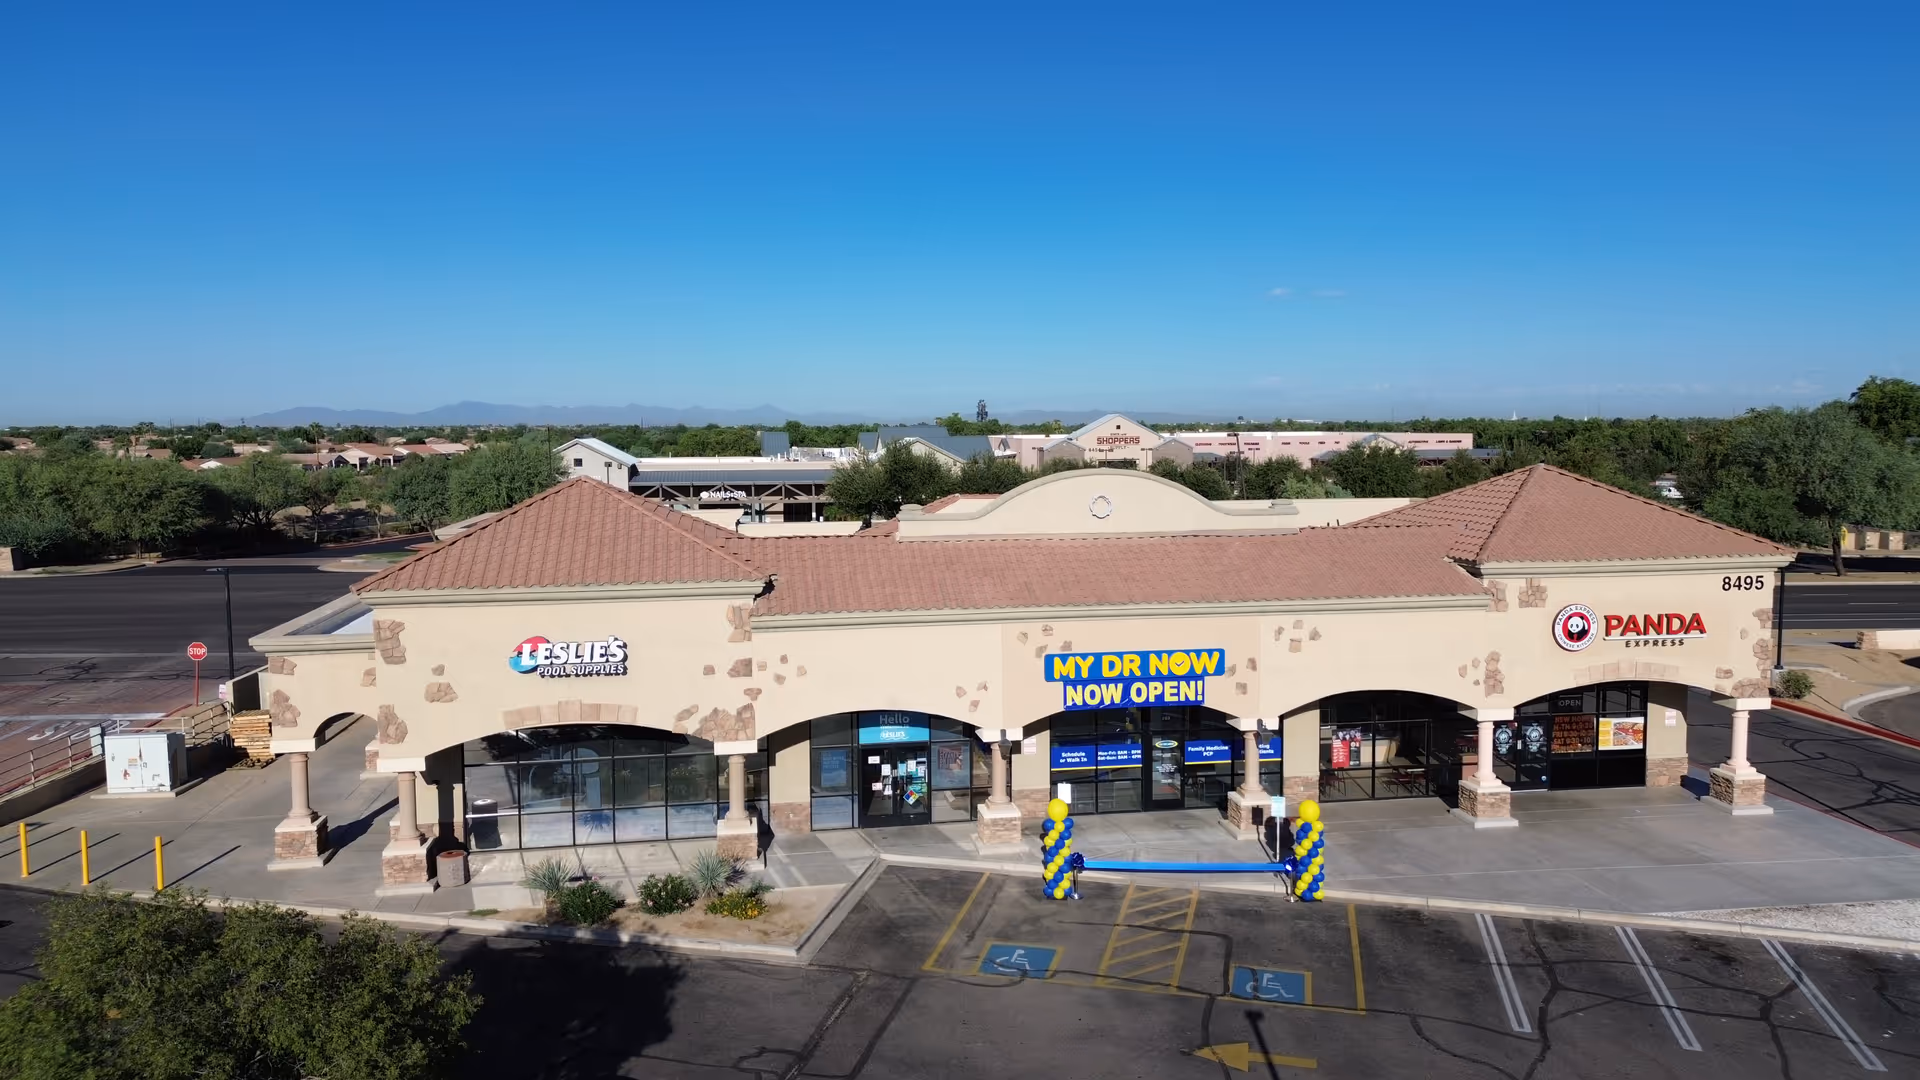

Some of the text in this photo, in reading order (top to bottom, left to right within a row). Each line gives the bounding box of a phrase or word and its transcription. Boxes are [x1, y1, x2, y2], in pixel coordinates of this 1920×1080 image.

[1096, 437, 1140, 445] SHOPPERS
[1722, 575, 1765, 591] 8495
[1557, 605, 1596, 626] PANDA EXPRESS
[1604, 613, 1707, 636] PANDA
[520, 635, 627, 666] LESLIE'S
[1625, 638, 1685, 648] EXPRESS
[189, 647, 206, 655] STOP
[536, 663, 627, 677] POOL SUPPLIES
[1053, 651, 1220, 679] MY DR NOW
[1066, 680, 1204, 706] NOW OPEN!
[1559, 699, 1581, 707] OPEN
[880, 712, 910, 724] Hello
